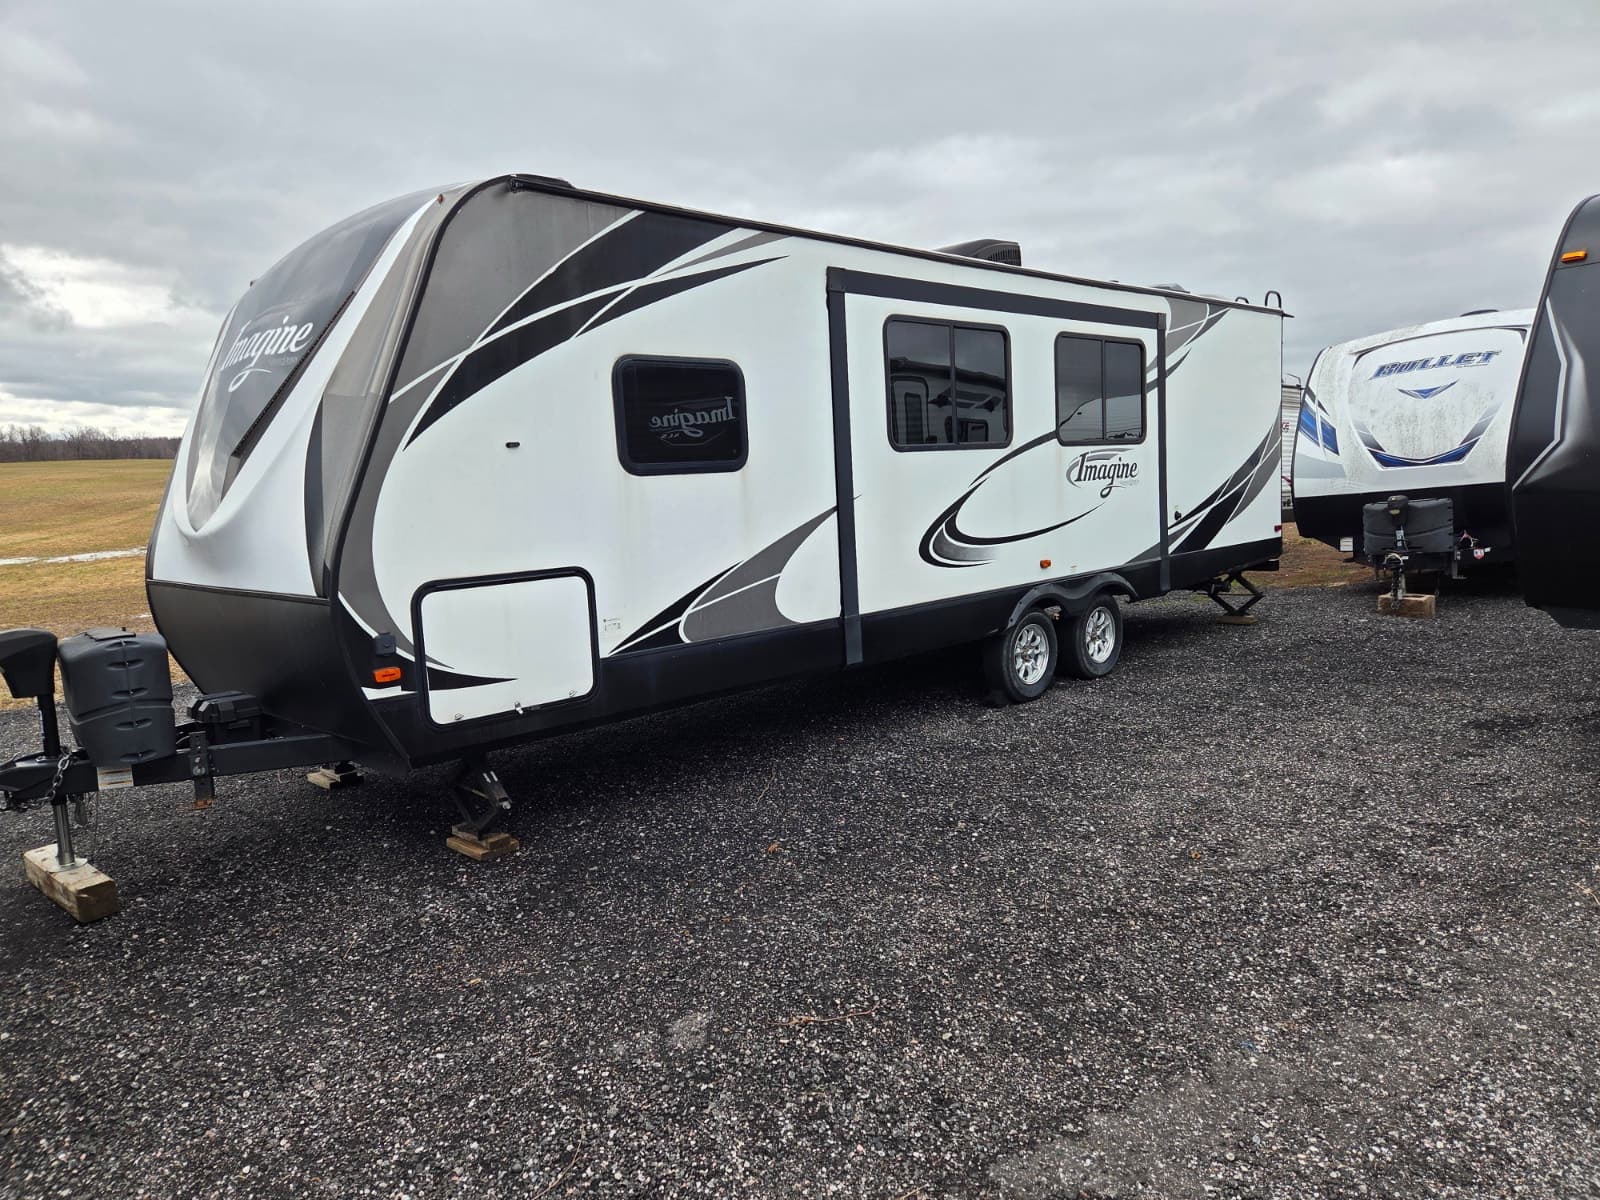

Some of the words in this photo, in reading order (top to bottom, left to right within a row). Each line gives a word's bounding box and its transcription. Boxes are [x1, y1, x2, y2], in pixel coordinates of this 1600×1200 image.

[220, 315, 313, 393] Imagine
[1368, 349, 1502, 380] BULLET
[1074, 451, 1138, 499] Imagine
